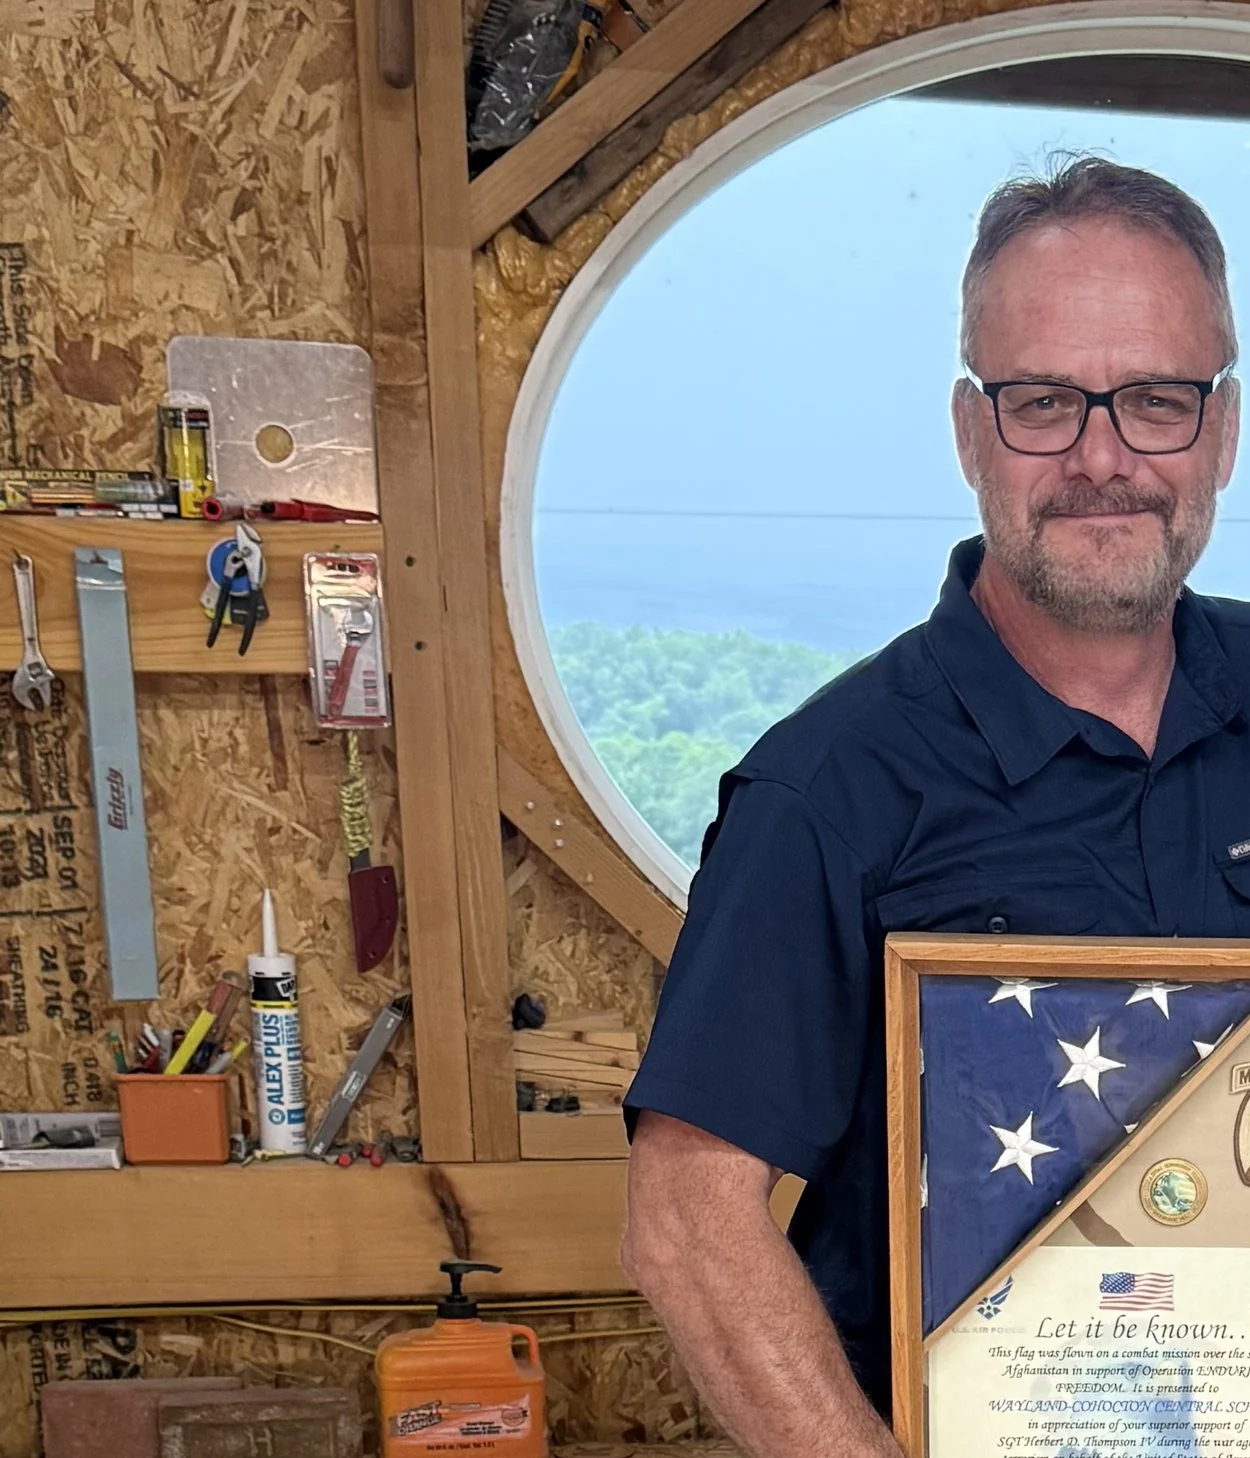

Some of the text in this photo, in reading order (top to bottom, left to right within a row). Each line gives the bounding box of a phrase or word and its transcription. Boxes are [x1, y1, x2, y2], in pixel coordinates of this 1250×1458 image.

[105, 766, 127, 831] Grizzly
[52, 814, 75, 860] SEP
[6, 936, 31, 1033] SHEATHING
[262, 1012, 285, 1106] ALEX PLUS
[60, 1062, 81, 1106] INCH
[1034, 1316, 1077, 1338] Let
[1085, 1316, 1105, 1338] it
[1112, 1314, 1138, 1339] be
[988, 1345, 1012, 1358] This
[1013, 1345, 1036, 1361] flag
[1039, 1350, 1061, 1358] was
[1060, 1346, 1094, 1361] flown
[1096, 1350, 1109, 1358] on
[1112, 1350, 1119, 1358] a
[1121, 1347, 1159, 1359] combat
[1162, 1348, 1201, 1359] mission
[1203, 1350, 1227, 1358] over
[1228, 1347, 1245, 1359] the
[1001, 1363, 1070, 1379] Afghanistan
[1072, 1365, 1083, 1376] in
[1085, 1366, 1125, 1379] support
[1127, 1364, 1143, 1379] of
[1142, 1365, 1194, 1380] Operation
[1132, 1383, 1143, 1393] It
[1145, 1383, 1154, 1393] is
[1156, 1382, 1207, 1397] presented
[1208, 1383, 1220, 1393] to
[988, 1399, 1155, 1413] WAYLAND-COHOCTON
[1154, 1400, 1224, 1414] CENTRAL
[1028, 1418, 1249, 1434] in appreciation of your superior support of
[996, 1436, 1025, 1450] SGT
[1023, 1434, 1064, 1447] Herbert
[1083, 1435, 1137, 1450] Thompson
[1139, 1436, 1156, 1447] IV
[1157, 1435, 1192, 1450] during
[1194, 1435, 1211, 1447] the
[1213, 1439, 1235, 1447] war
